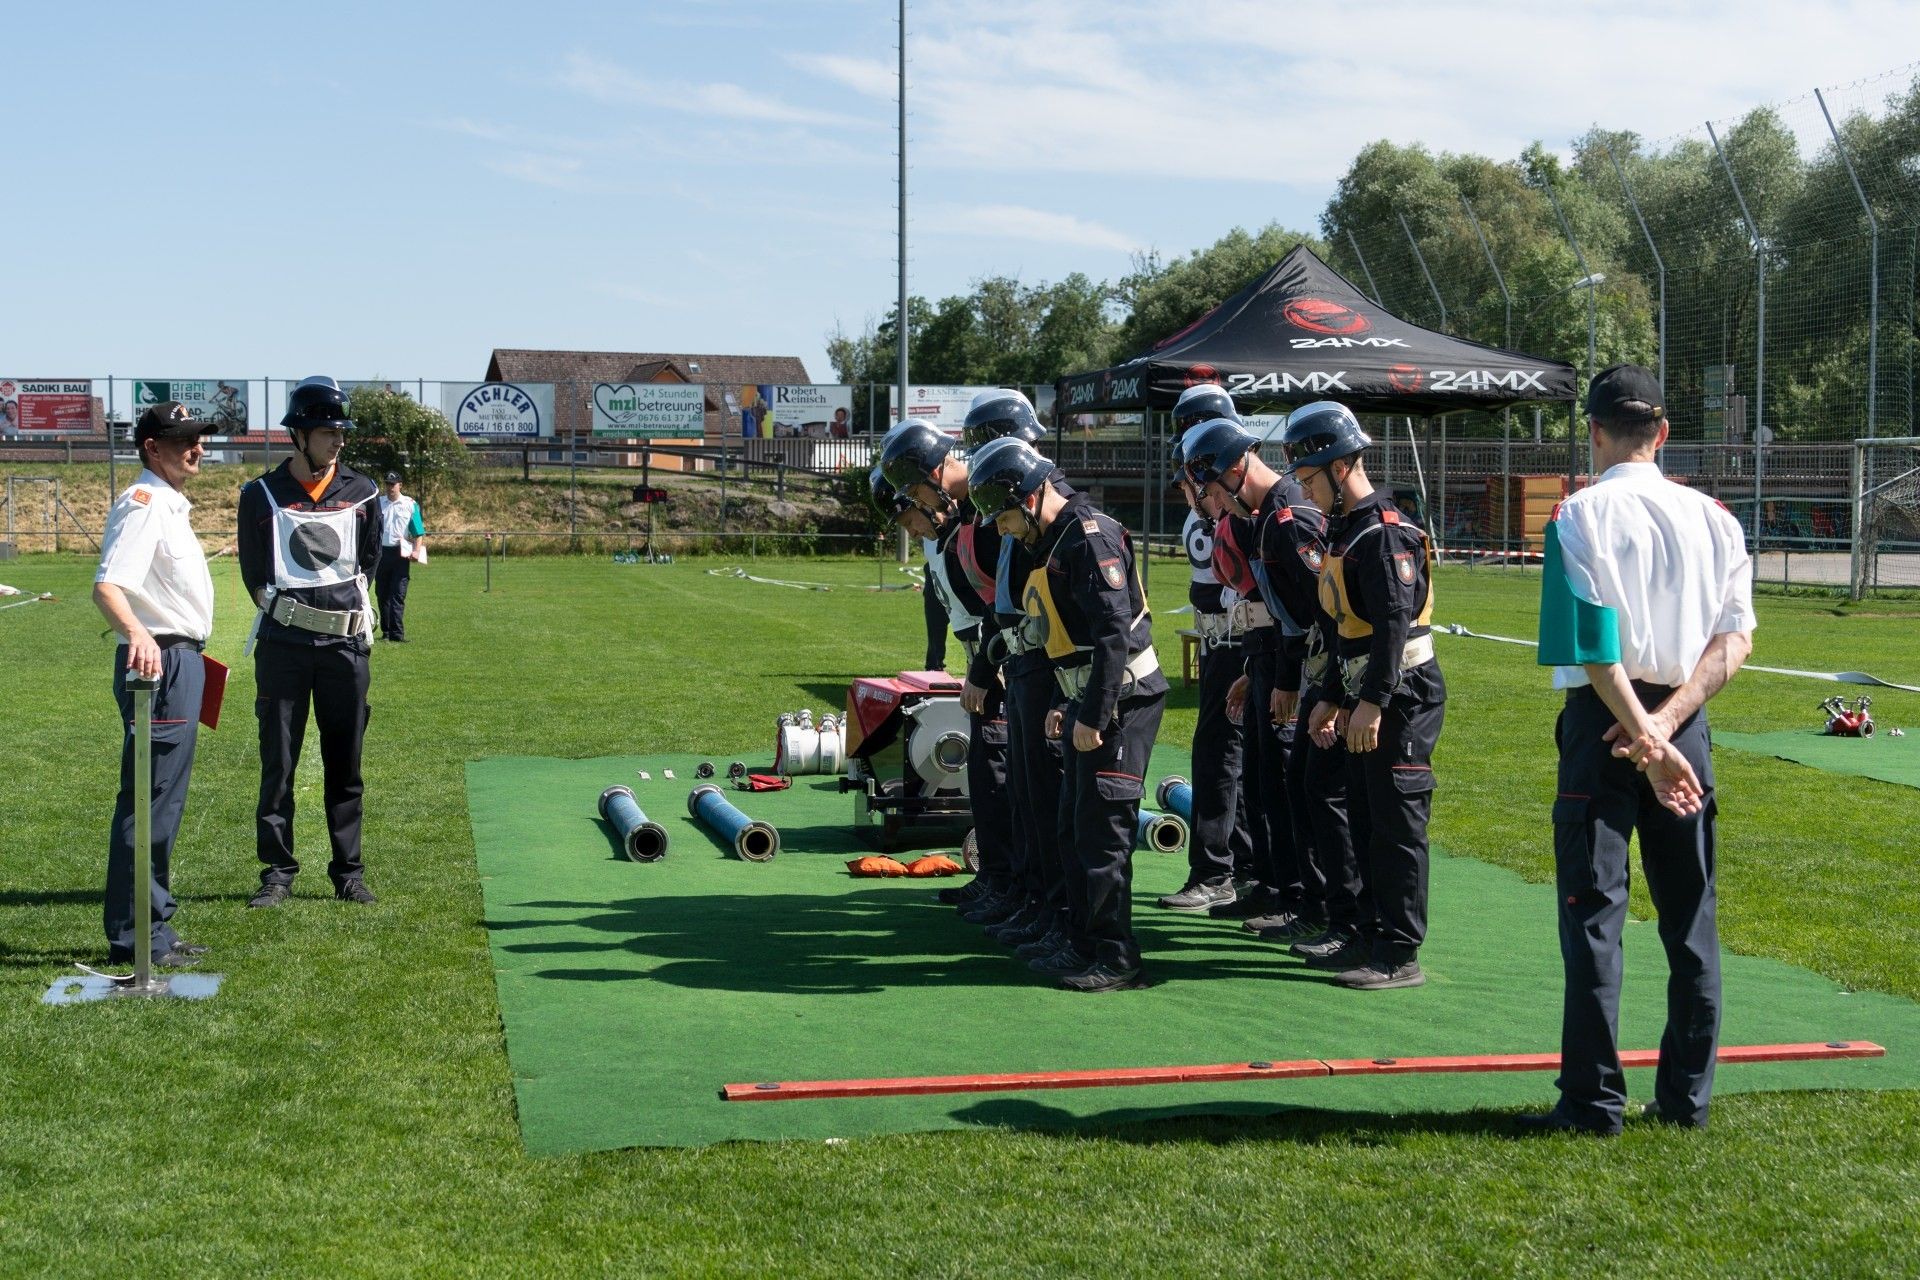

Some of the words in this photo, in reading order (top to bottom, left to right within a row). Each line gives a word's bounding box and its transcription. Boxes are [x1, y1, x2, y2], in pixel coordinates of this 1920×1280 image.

[1290, 337, 1412, 349] 24MX
[1228, 370, 1352, 395] 24MX
[1430, 370, 1548, 391] 24MX
[22, 384, 60, 393] SADIKI
[63, 384, 87, 393] BAU
[171, 382, 206, 392] draht
[1111, 377, 1140, 400] 24MX
[171, 392, 206, 401] eisel
[643, 388, 655, 399] 24
[658, 388, 699, 399] Stunden
[1070, 382, 1095, 405] 24MX
[466, 387, 532, 414] PICHLER
[661, 414, 672, 422] 61
[674, 414, 685, 422] 37
[492, 422, 503, 432] 16
[504, 422, 515, 432] 61
[517, 422, 534, 432] 800
